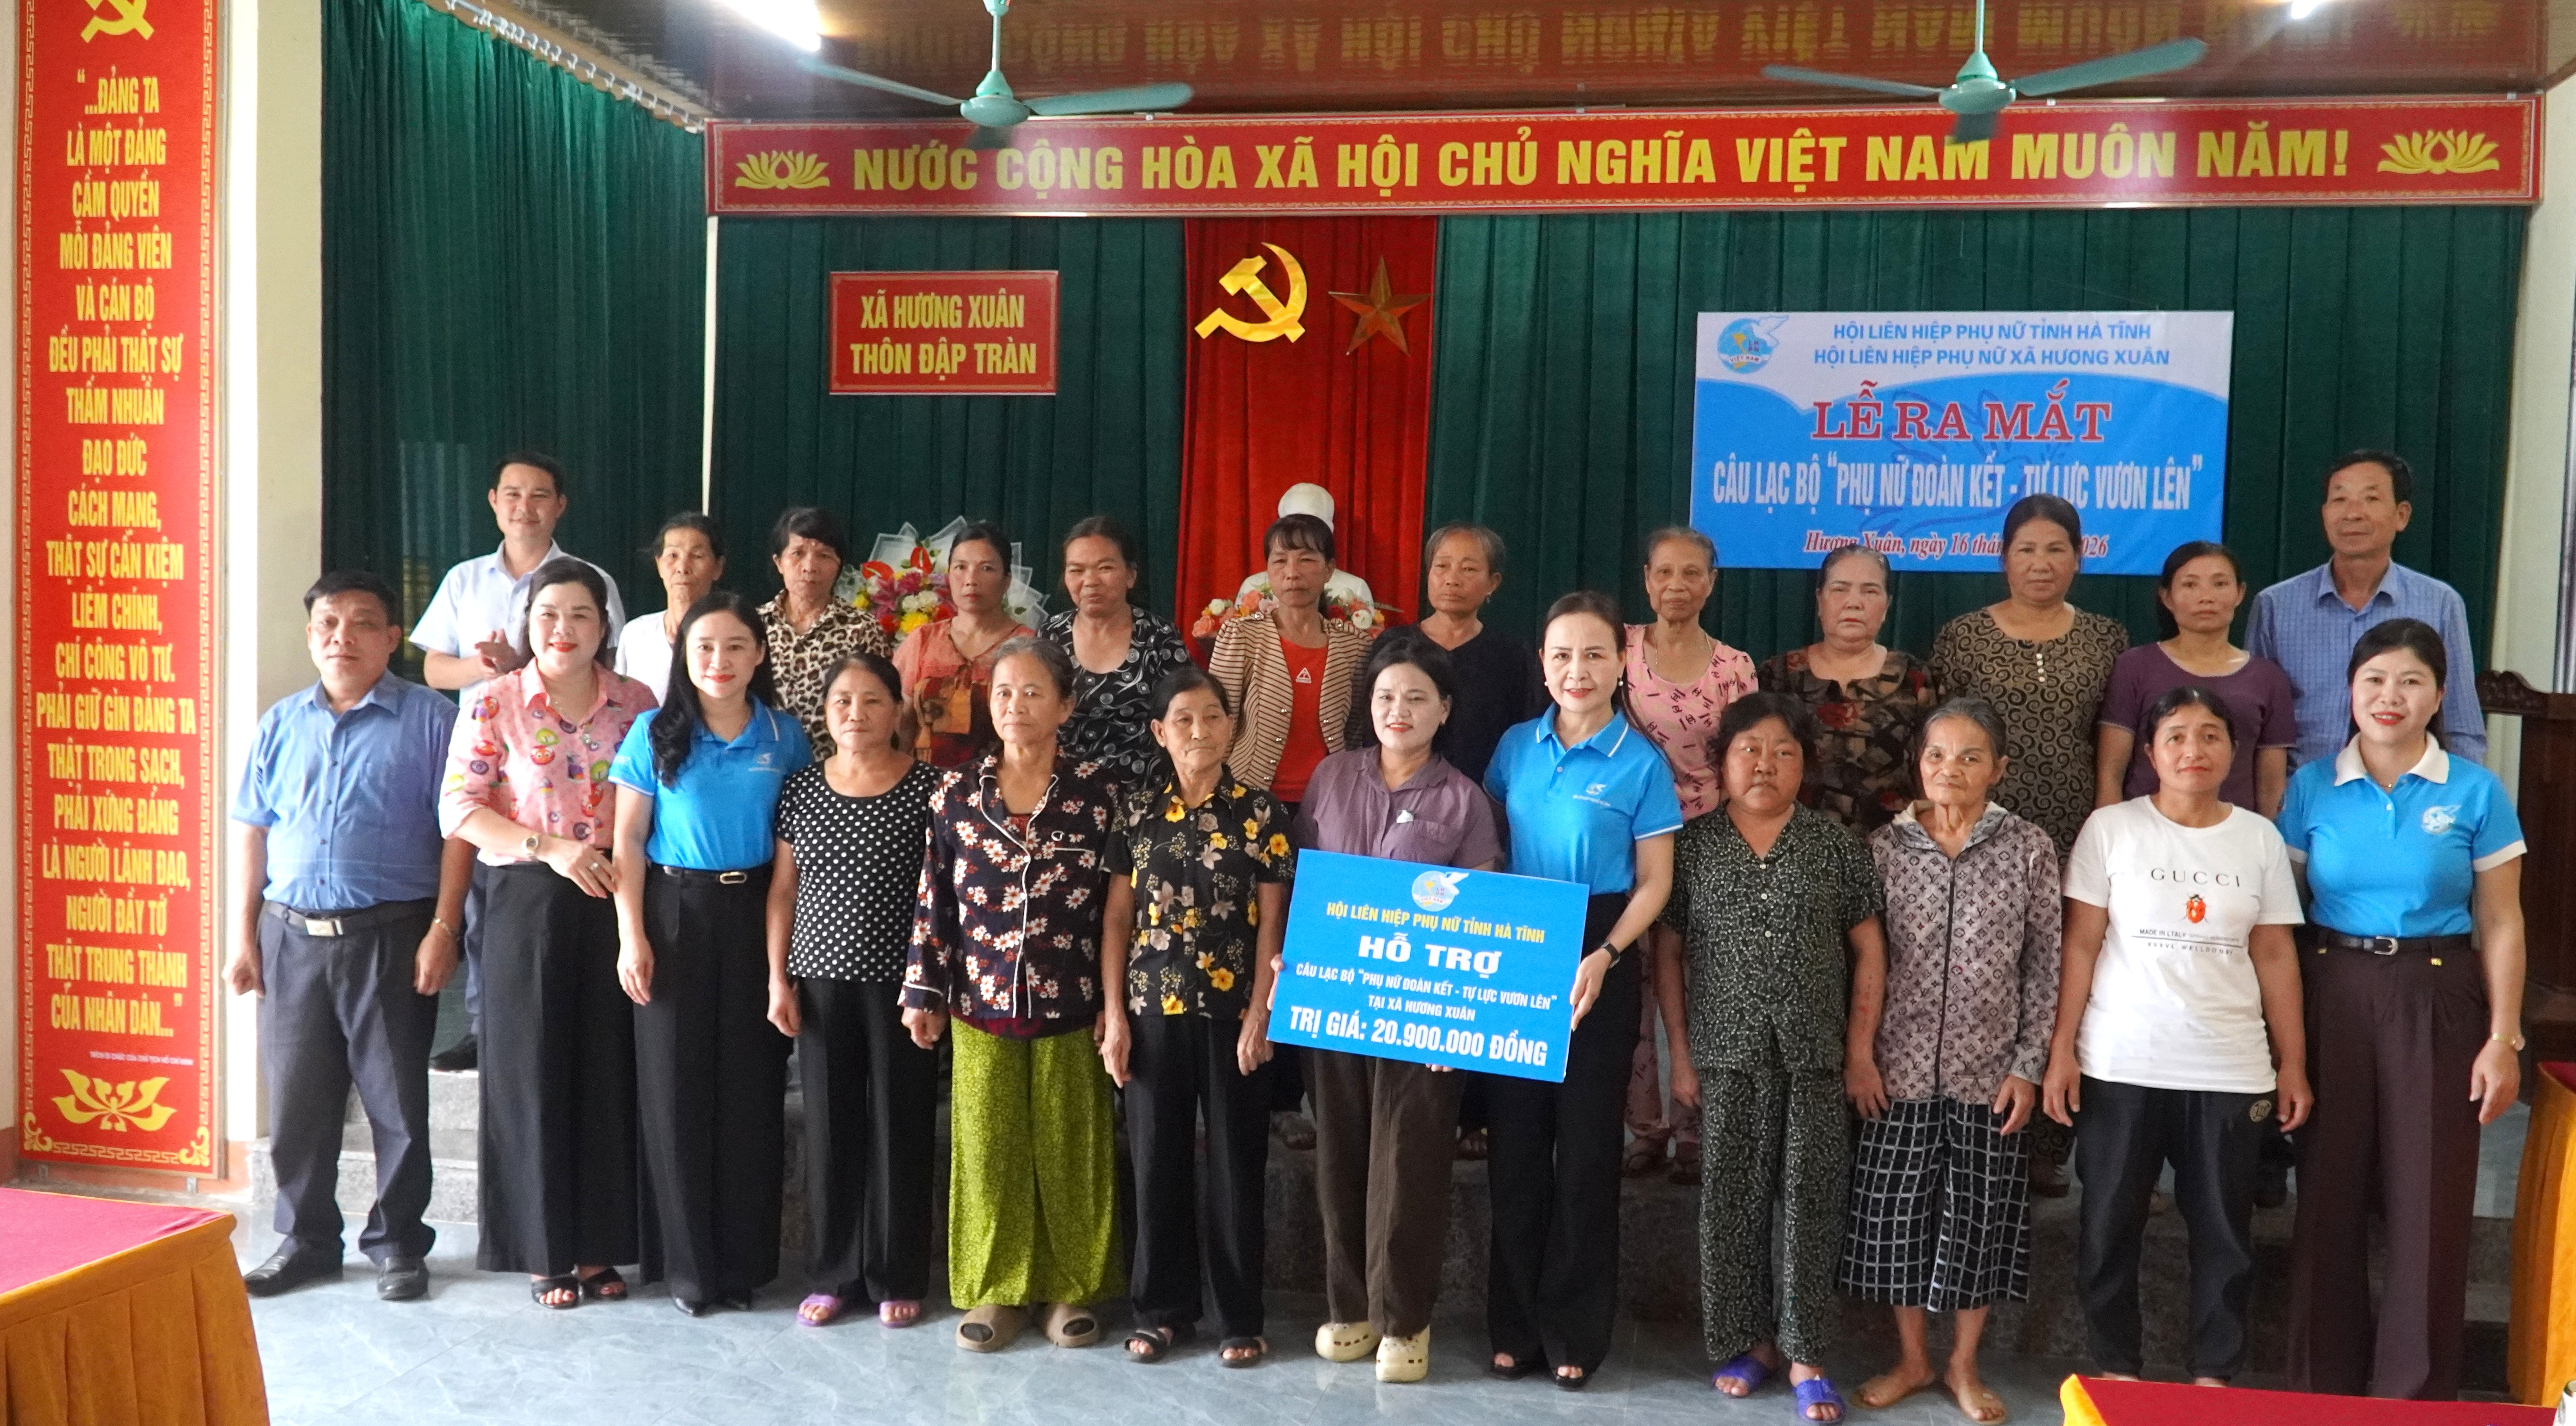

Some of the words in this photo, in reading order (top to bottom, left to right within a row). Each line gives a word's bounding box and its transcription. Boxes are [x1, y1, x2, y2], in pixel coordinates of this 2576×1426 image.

[143, 76, 160, 113] TA
[67, 122, 85, 166] LÀ
[89, 121, 122, 174] MỘT
[125, 115, 166, 166] ĐẢNG
[853, 139, 978, 191] NƯỚC
[995, 139, 1123, 199] CỘNG
[1141, 135, 1237, 189] HÒA
[1254, 135, 1320, 189] XÃ
[1338, 134, 1419, 197] HỘI
[1438, 126, 1538, 186] CHỦ
[1557, 131, 1716, 185] NGHĨA
[1737, 128, 1847, 193] VIỆT
[1865, 135, 1989, 181] NAM
[2011, 122, 2176, 180] MUÔN
[2196, 120, 2348, 178] NĂM!
[72, 168, 106, 217] CẦM
[110, 168, 159, 222] QUYỀN
[59, 220, 88, 270] MỖI
[92, 220, 133, 270] ĐẢNG
[137, 225, 172, 269] VIÊN
[76, 276, 95, 321] VÀ
[99, 276, 130, 321] CÁN
[134, 277, 155, 329] BỘ
[860, 289, 888, 329] XÃ
[893, 291, 963, 329] HƯƠNG
[968, 287, 1025, 328] XUÂN
[49, 324, 78, 372] ĐỀU
[82, 323, 117, 373] PHẢI
[121, 329, 157, 381] THẬT
[161, 332, 184, 382] SỰ
[1833, 320, 1864, 343] HỘI
[1869, 320, 1907, 339] LIÊN
[1912, 321, 1951, 343] HIỆP
[1956, 325, 1993, 344] PHỤ
[1998, 320, 2026, 339] NỮ
[2030, 319, 2072, 339] TỈNH
[2077, 320, 2103, 339] HÀ
[2108, 320, 2151, 339] TĨNH
[850, 336, 912, 374] THÔN
[918, 336, 967, 381] ĐẬP
[974, 336, 1036, 374] TRÀN
[1814, 345, 1844, 368] HỘI
[1849, 345, 1888, 364] LIÊN
[1892, 346, 1932, 368] HIỆP
[1937, 349, 1973, 369] PHỤ
[1979, 346, 2006, 365] NỮ
[2011, 346, 2036, 365] XÃ
[2041, 348, 2109, 365] HƯƠNG
[2114, 345, 2170, 365] XUÂN
[66, 375, 108, 424] THẤM
[112, 375, 164, 425] NHUẦN
[1811, 379, 1882, 440] LỄ
[1891, 401, 1972, 441] RA
[1982, 378, 2112, 442] MẮT
[82, 438, 113, 483] ĐẠO
[117, 431, 147, 476] ĐỨC
[1713, 452, 1751, 504] CÂU
[1755, 462, 1790, 514] LẠC
[1795, 453, 1820, 514] BỘ
[1879, 454, 1909, 506] NỮ
[1911, 454, 1964, 507] ĐOÀN
[1969, 450, 2005, 508] KẾT
[2010, 484, 2018, 494] -
[2095, 461, 2147, 510] VƯƠN
[68, 482, 108, 527] CÁCH
[46, 533, 82, 585] THẬT
[86, 538, 108, 586] SỰ
[145, 536, 184, 588] KIỆM
[1909, 532, 1946, 558] ngày
[1950, 533, 1968, 555] 16
[72, 585, 108, 629] LIÊM
[112, 586, 162, 635] CHÍNH,
[55, 635, 81, 679] CHÍ
[84, 636, 125, 681] CÔNG
[128, 637, 148, 682] VÔ
[152, 643, 176, 682] TƯ.
[36, 681, 71, 728] PHẢI
[75, 687, 101, 730] GIỮ
[104, 687, 130, 731] GÌN
[134, 684, 175, 734] ĐẢNG
[178, 697, 196, 735] TA
[47, 737, 84, 788] THẬT
[87, 745, 135, 782] TRONG
[54, 783, 89, 830] PHẢI
[92, 789, 134, 833] XỨNG
[42, 836, 61, 880] LÀ
[64, 837, 110, 883] NGƯỜI
[114, 841, 153, 885] LÃNH
[156, 850, 191, 894] ĐẠO,
[2151, 867, 2240, 887] GUCCI
[66, 887, 112, 933] NGƯỜI
[115, 886, 145, 935] ĐẦY
[148, 893, 167, 937] TỚ
[1326, 900, 1348, 920] HỘI
[1351, 904, 1378, 921] LIÊN
[1381, 908, 1410, 927] HIỆP
[1413, 913, 1439, 932] PHỤ
[1441, 916, 1462, 932] NỮ
[1464, 916, 1492, 936] TỈNH
[1495, 922, 1512, 939] HÀ
[1516, 925, 1545, 943] TĨNH
[46, 937, 82, 987] THẬT
[86, 946, 135, 984] TRUNG
[137, 943, 187, 988] THÀNH
[1358, 932, 1411, 962] HỖ
[1424, 944, 1502, 979] TRỢ
[51, 982, 81, 1030] CỦA
[84, 990, 126, 1034] NHÂN
[1296, 962, 1317, 977] CÂU
[1318, 966, 1338, 982] LẠC
[1340, 968, 1355, 985] BỘ
[1385, 975, 1403, 989] NỮ
[1402, 978, 1432, 993] ĐOÀN
[1433, 980, 1453, 996] KẾT
[1463, 986, 1477, 1002] TỰ
[1477, 988, 1497, 1004] LỰC
[1500, 991, 1528, 1007] VƯƠN
[1368, 994, 1385, 1010] TẠI
[1387, 997, 1402, 1011] XÃ
[1405, 1000, 1442, 1017] HƯƠNG
[1445, 1006, 1476, 1021] XUÂN
[1290, 1006, 1322, 1038] TRỊ
[1326, 1010, 1367, 1040] GIÁ:
[1371, 1018, 1485, 1057] 20.900.000
[1489, 1029, 1548, 1066] ĐỒNG
